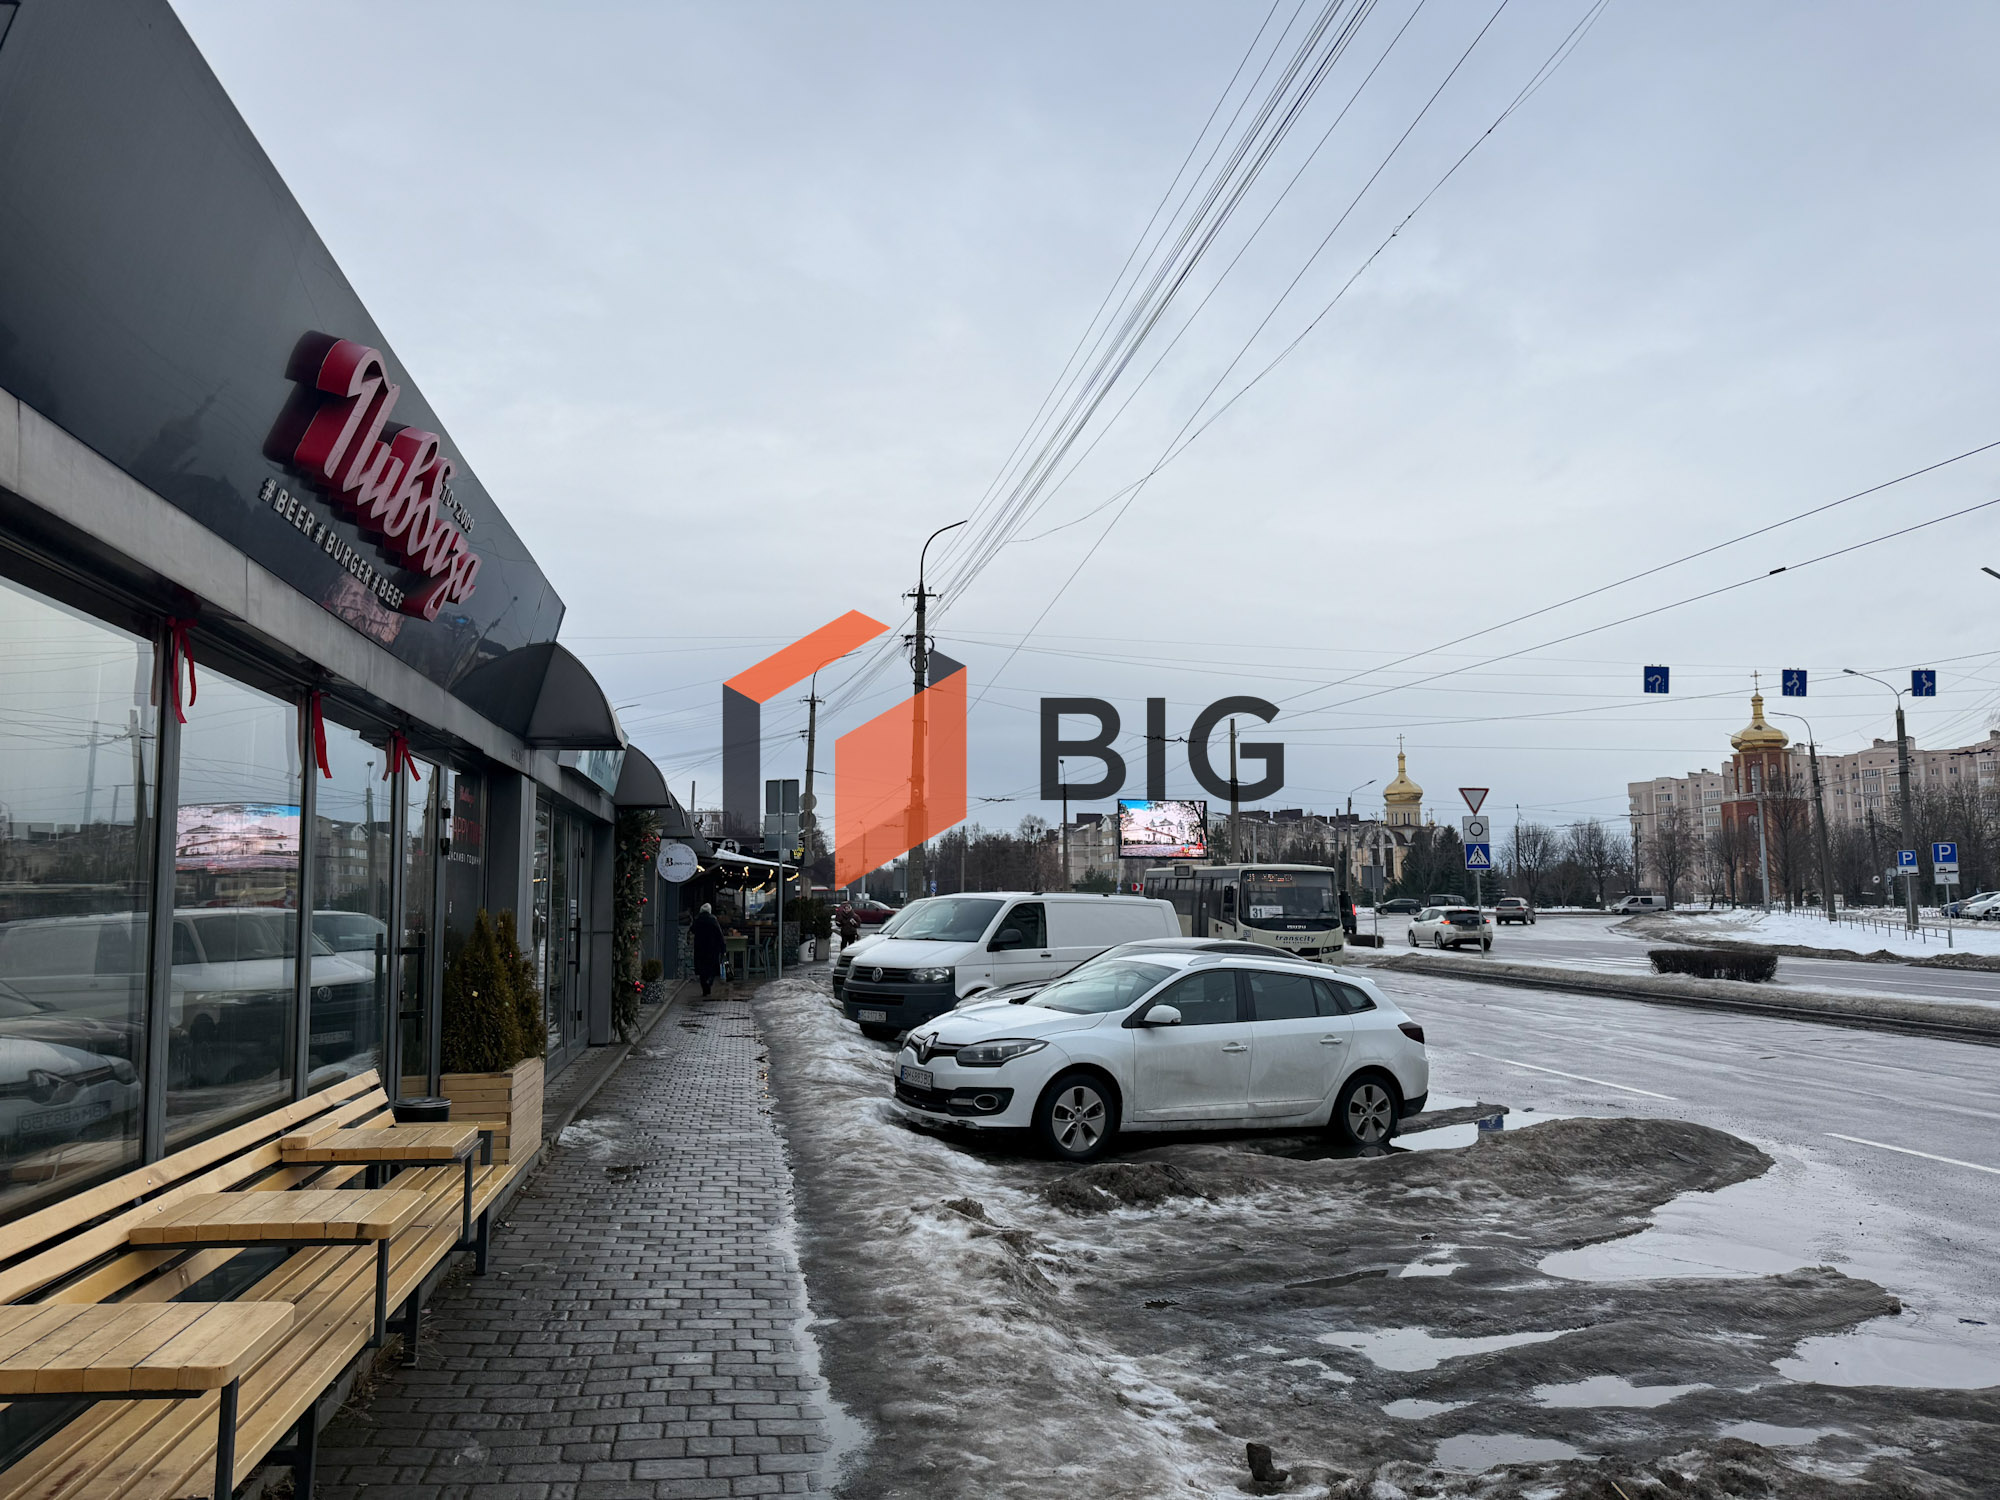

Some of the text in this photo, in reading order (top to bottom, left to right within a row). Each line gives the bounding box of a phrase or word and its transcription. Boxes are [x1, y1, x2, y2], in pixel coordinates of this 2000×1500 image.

[455, 502, 475, 533] 2009
[1902, 852, 1913, 864] P
[1939, 844, 1951, 861] P
[1252, 907, 1263, 918] 31
[1275, 935, 1316, 943] transcity
